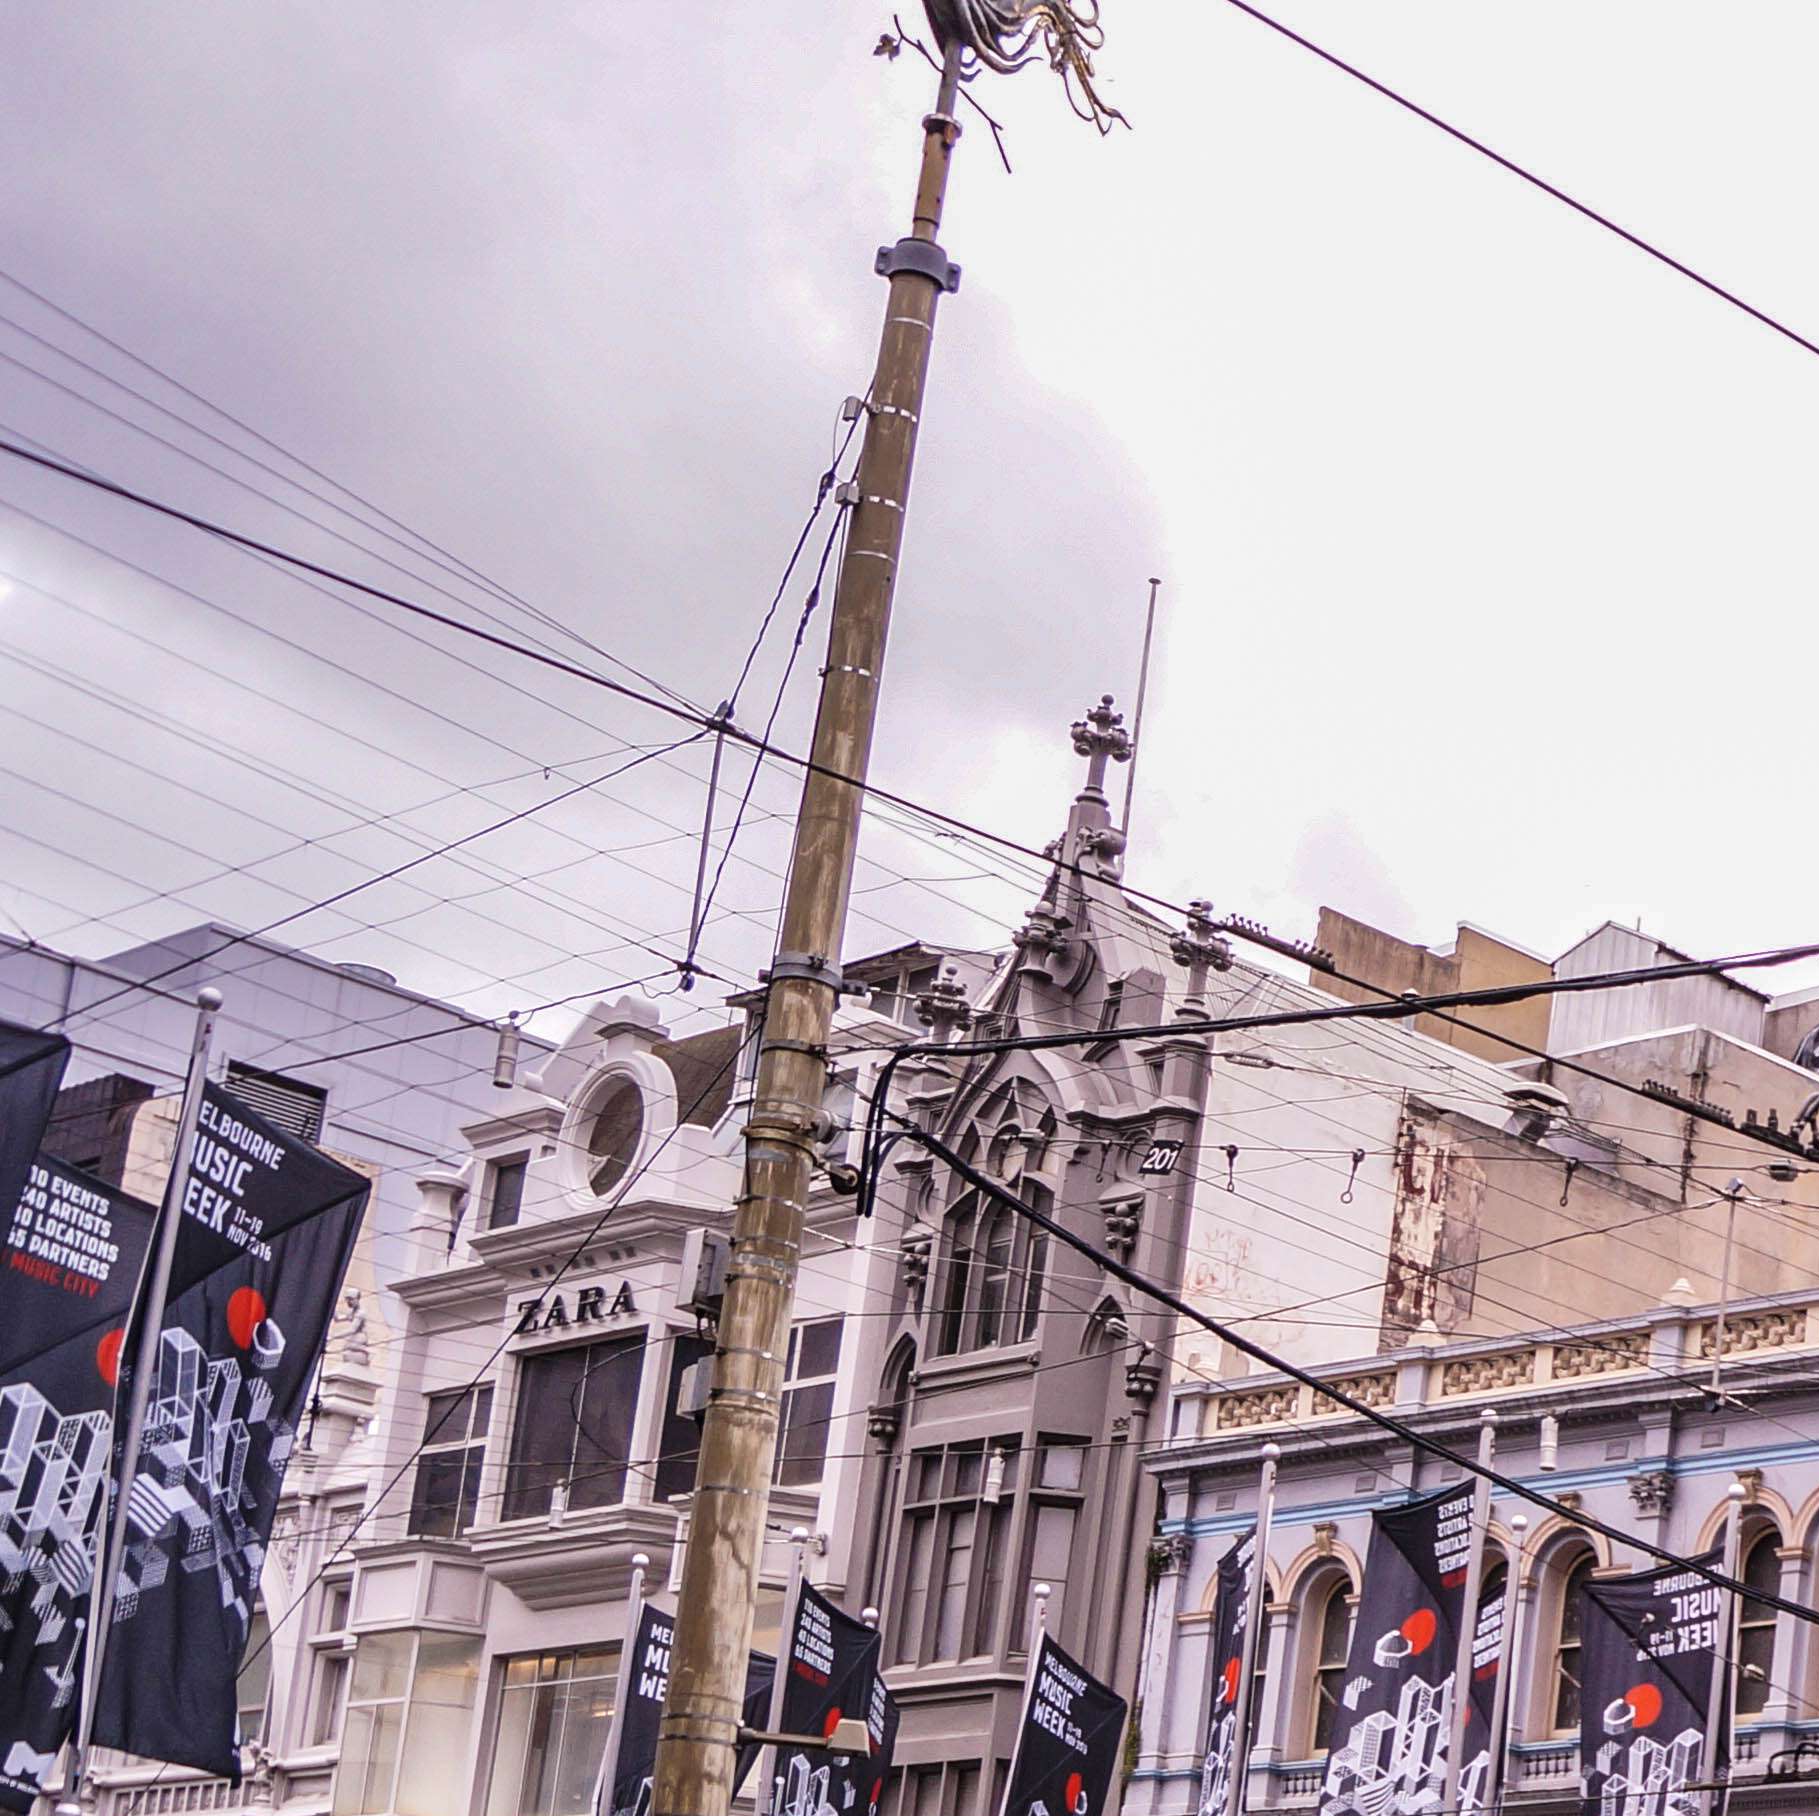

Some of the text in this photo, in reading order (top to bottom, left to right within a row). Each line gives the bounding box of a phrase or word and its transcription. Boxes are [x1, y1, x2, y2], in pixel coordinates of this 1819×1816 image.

[198, 1100, 285, 1170] ELBOURNE
[30, 1165, 110, 1216] 10 EVENTS
[182, 1177, 232, 1233] EEK
[35, 1214, 119, 1262] LOCATIONS
[50, 1198, 112, 1238] ARTISTS
[226, 1224, 250, 1247] NOV
[10, 1252, 102, 1297] MUSIC CITY
[29, 1235, 110, 1281] PARTNERS
[514, 1279, 638, 1334] ZARA
[1039, 1671, 1073, 1715] MUSIC
[1045, 1652, 1088, 1696] MELBOURNE
[1033, 1698, 1066, 1739] WEEK
